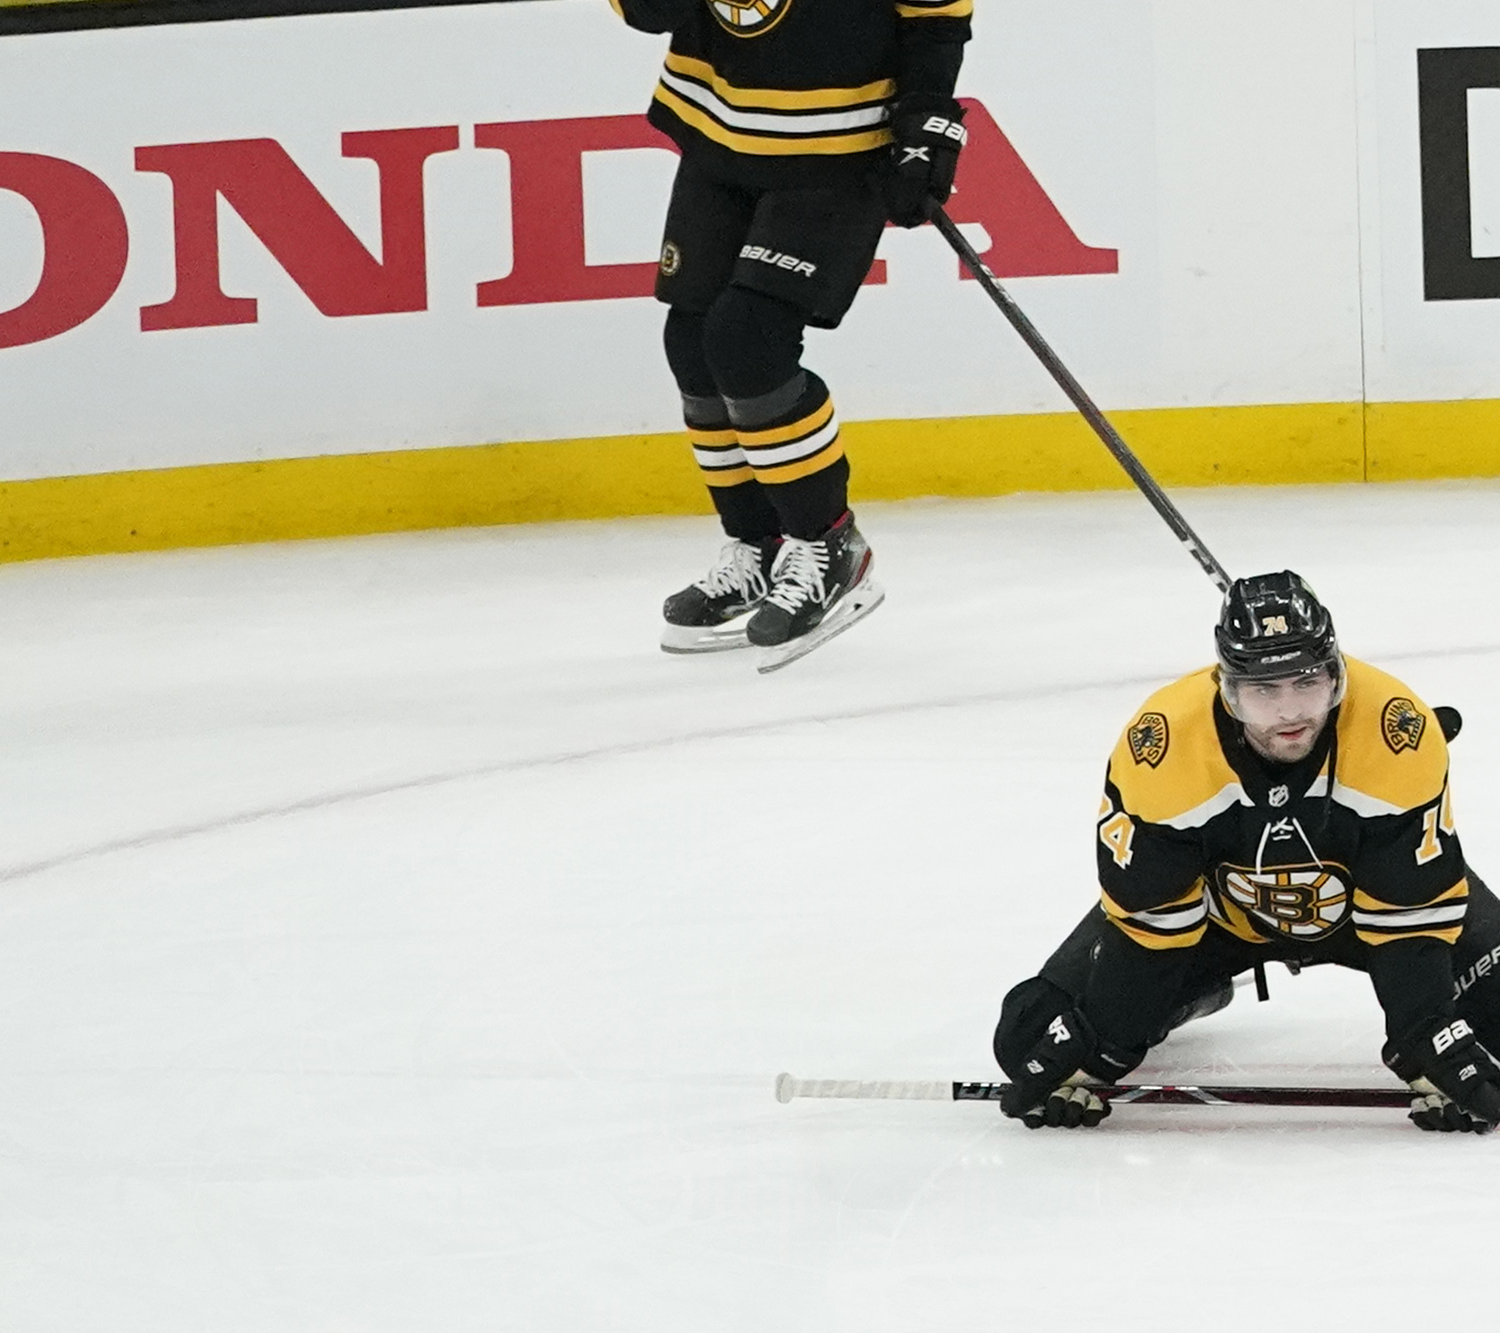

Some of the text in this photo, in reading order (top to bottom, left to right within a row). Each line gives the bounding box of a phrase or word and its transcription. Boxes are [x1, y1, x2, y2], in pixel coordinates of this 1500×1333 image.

[741, 244, 816, 278] BAUER
[1262, 615, 1289, 636] 74
[1257, 882, 1319, 924] B
